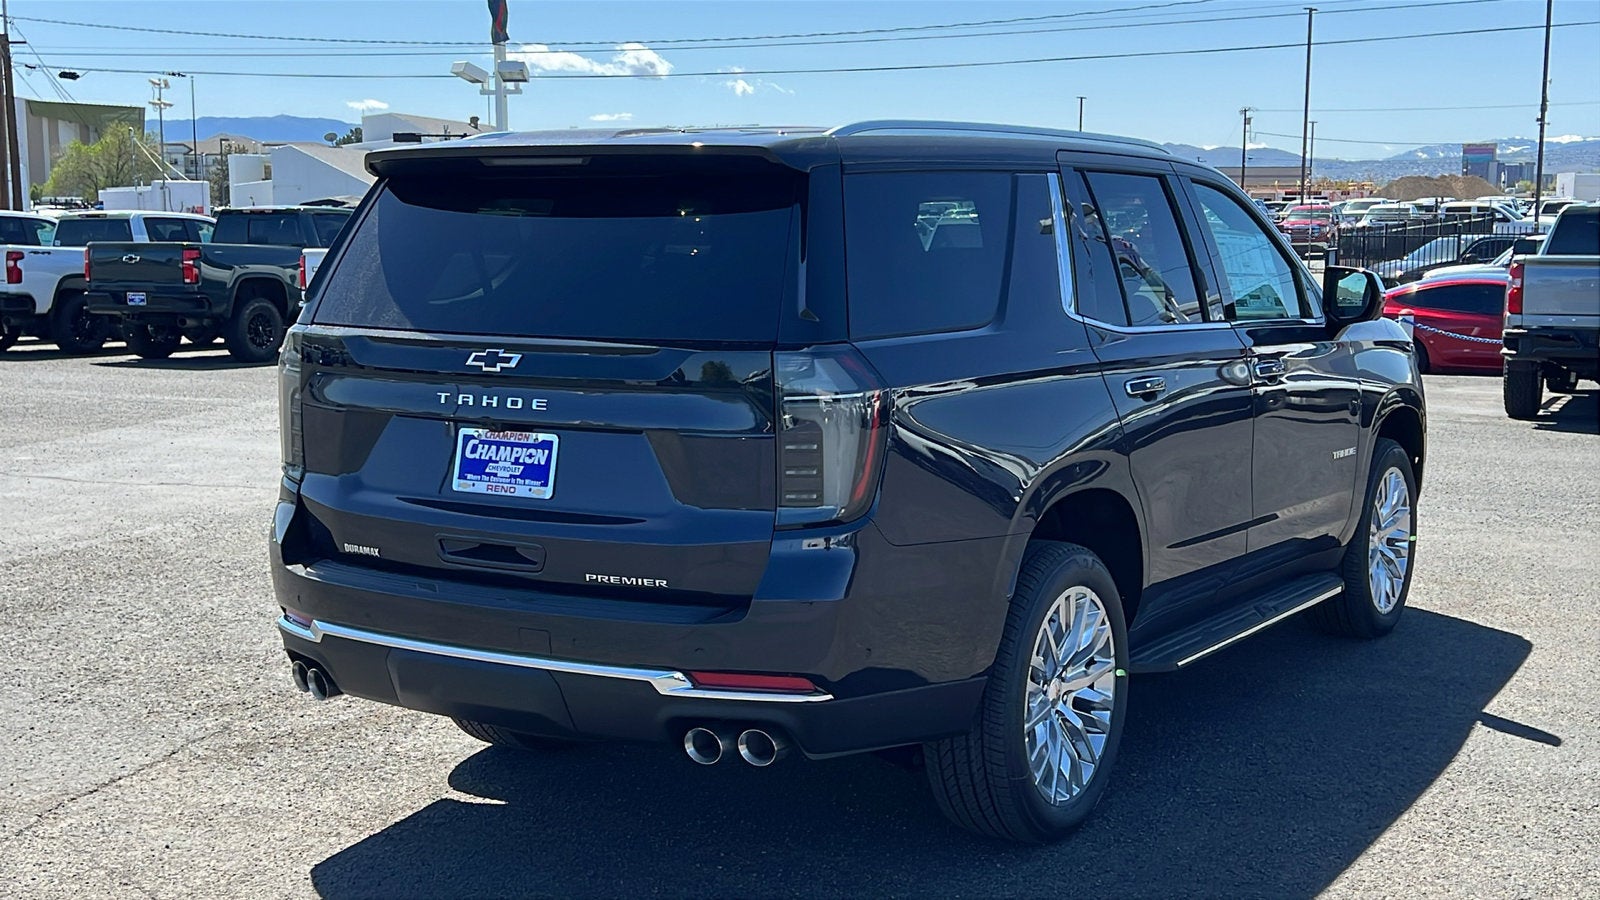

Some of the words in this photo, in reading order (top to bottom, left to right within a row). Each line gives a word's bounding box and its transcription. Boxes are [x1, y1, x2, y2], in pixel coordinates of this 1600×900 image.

[437, 392, 548, 410] TAHOE
[485, 431, 530, 441] CHAMPION
[465, 439, 549, 465] CHAMPION
[1333, 446, 1357, 459] TAHOE
[488, 464, 521, 474] CHEVROLET
[516, 477, 524, 485] The
[486, 484, 516, 494] RENO
[344, 543, 380, 557] DURAMAX
[585, 573, 669, 588] PREMIER
